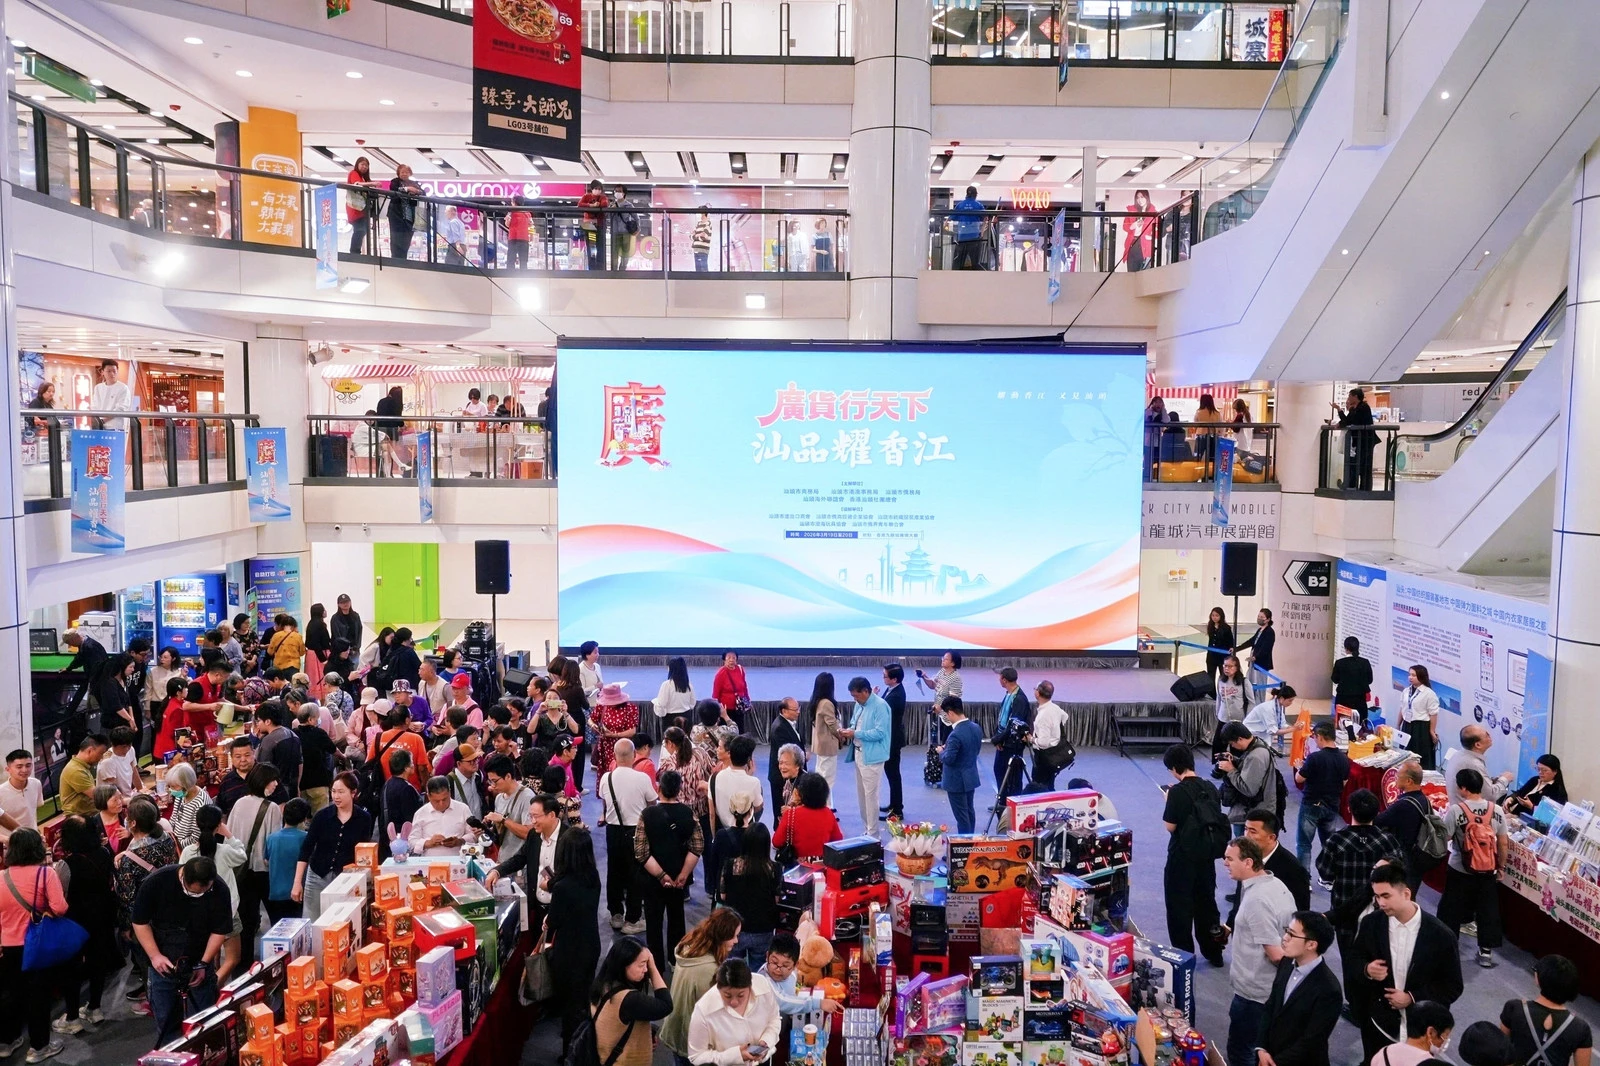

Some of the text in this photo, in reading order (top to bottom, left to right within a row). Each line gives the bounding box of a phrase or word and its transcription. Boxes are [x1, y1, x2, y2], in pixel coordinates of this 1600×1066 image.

[559, 15, 573, 26] 69
[1462, 387, 1480, 396] red
[755, 380, 934, 428] 廣貨行天下
[750, 427, 956, 469] 汕品耀香江
[1164, 503, 1191, 515] CITY
[1199, 503, 1276, 515] AUMOBILE
[1307, 575, 1328, 588] B2
[1289, 622, 1308, 631] CITY
[1280, 630, 1330, 641] AUTOMOBILE
